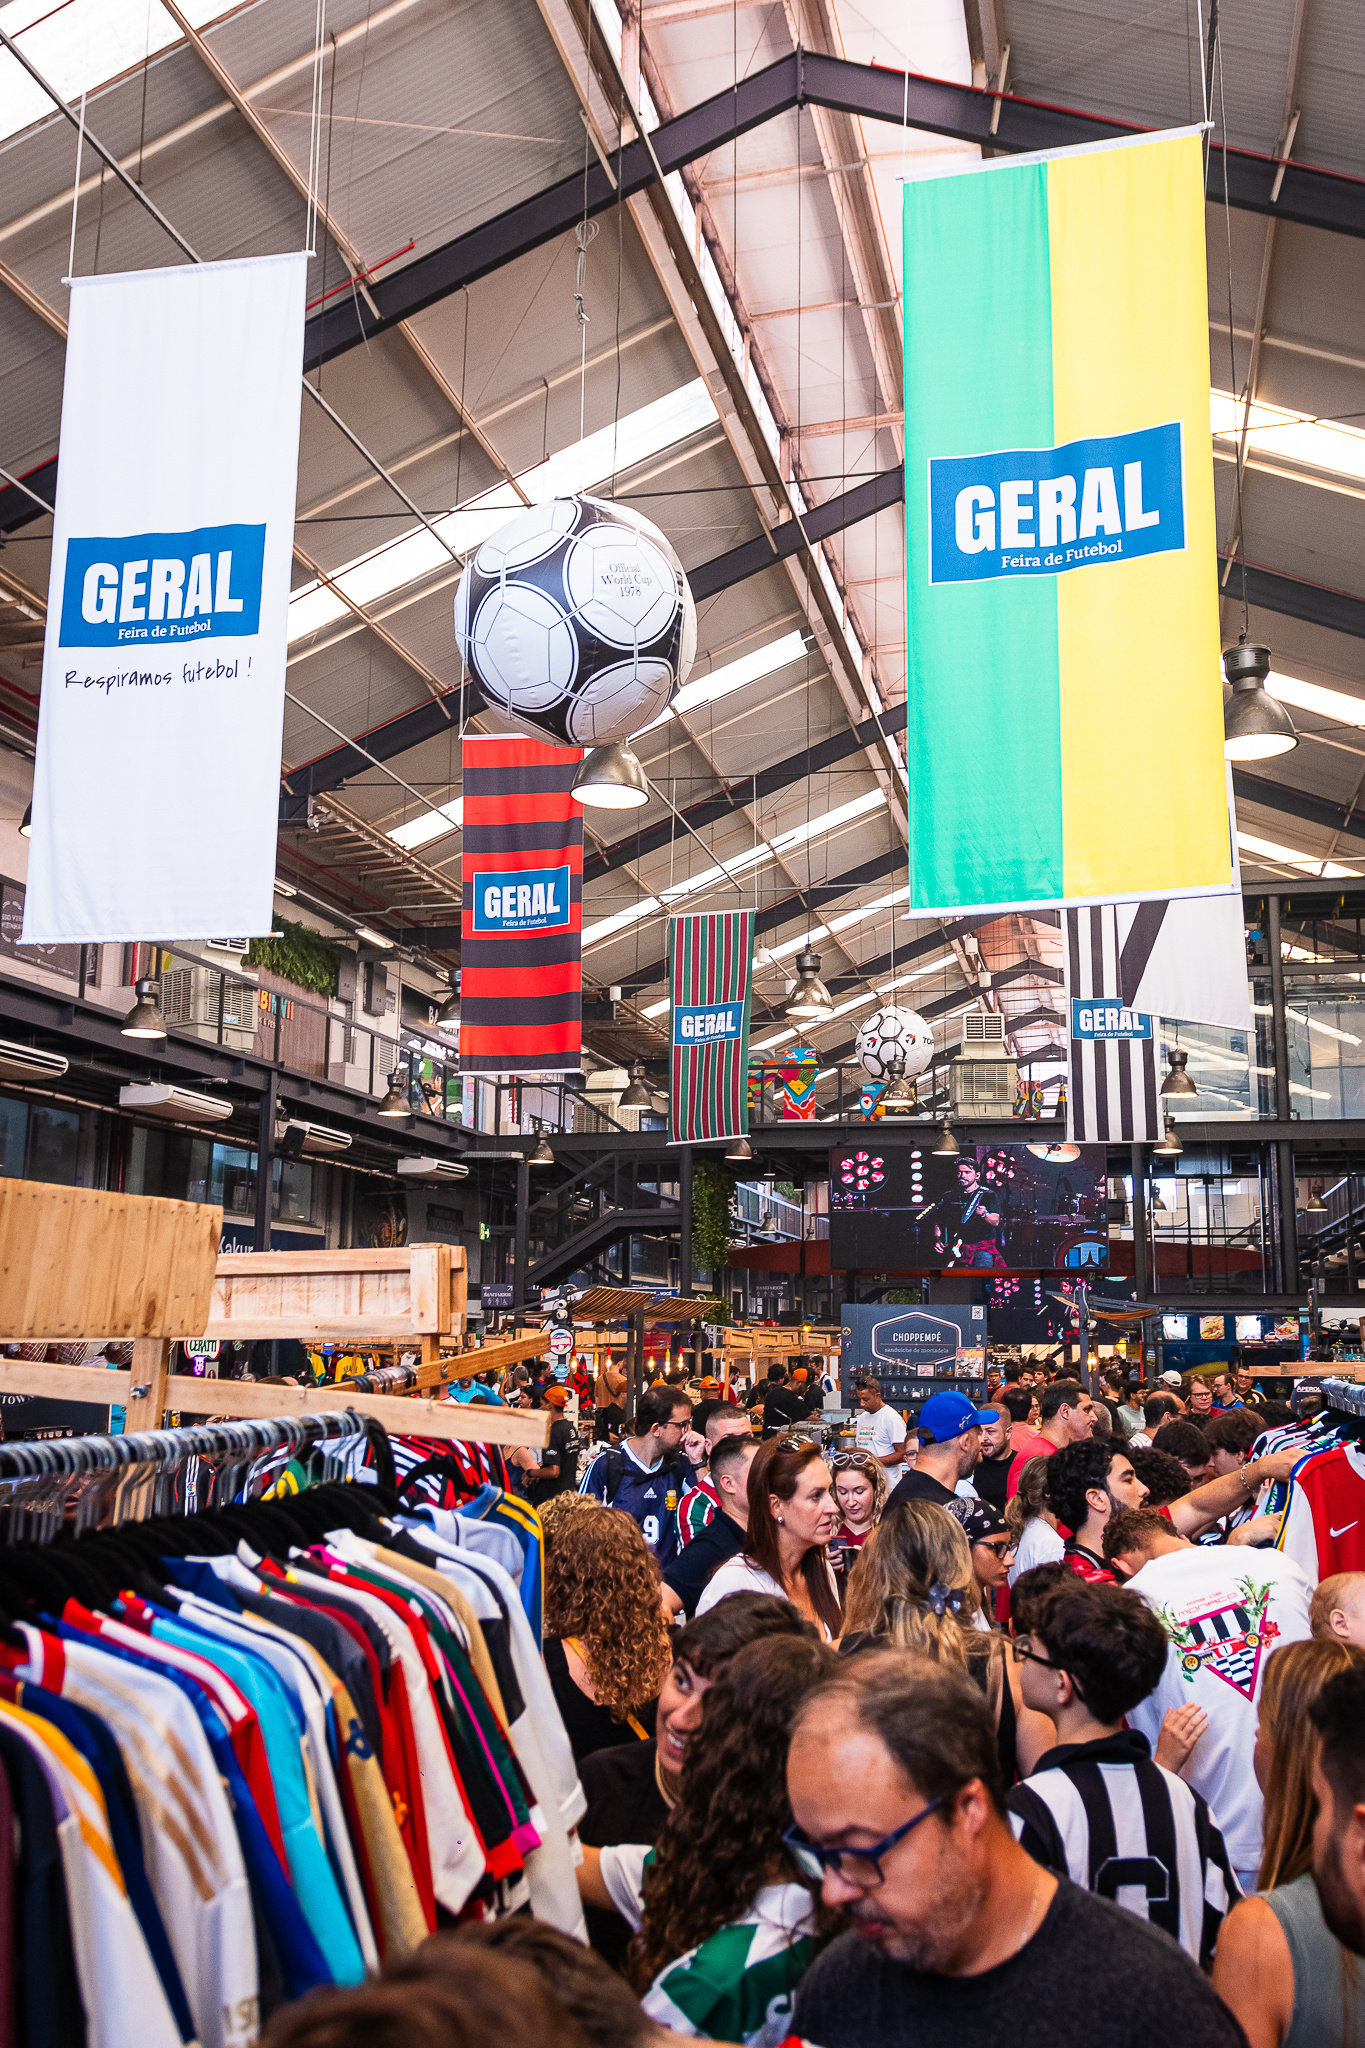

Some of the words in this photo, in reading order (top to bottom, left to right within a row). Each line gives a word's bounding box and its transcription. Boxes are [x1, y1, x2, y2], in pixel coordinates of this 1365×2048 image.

[955, 461, 1160, 554] GERAL
[1001, 555, 1041, 568] Feira
[1045, 552, 1063, 566] de
[1065, 540, 1123, 562] Futebol
[601, 574, 632, 584] World
[634, 574, 652, 586] Cup
[609, 563, 640, 573] Official
[81, 550, 243, 624] GERAL
[620, 586, 641, 597] 1978
[118, 628, 148, 639] Feira
[151, 625, 167, 637] de
[169, 619, 211, 636] Futebol
[65, 667, 172, 695] Respiramos
[183, 658, 238, 684] futebol
[484, 882, 560, 918] GERAL
[502, 919, 518, 927] Feira
[527, 917, 547, 926] Futebol
[681, 1010, 736, 1037] GERAL
[1079, 1007, 1144, 1031] GERAL
[892, 1331, 942, 1342] CHOPPEMPÉ
